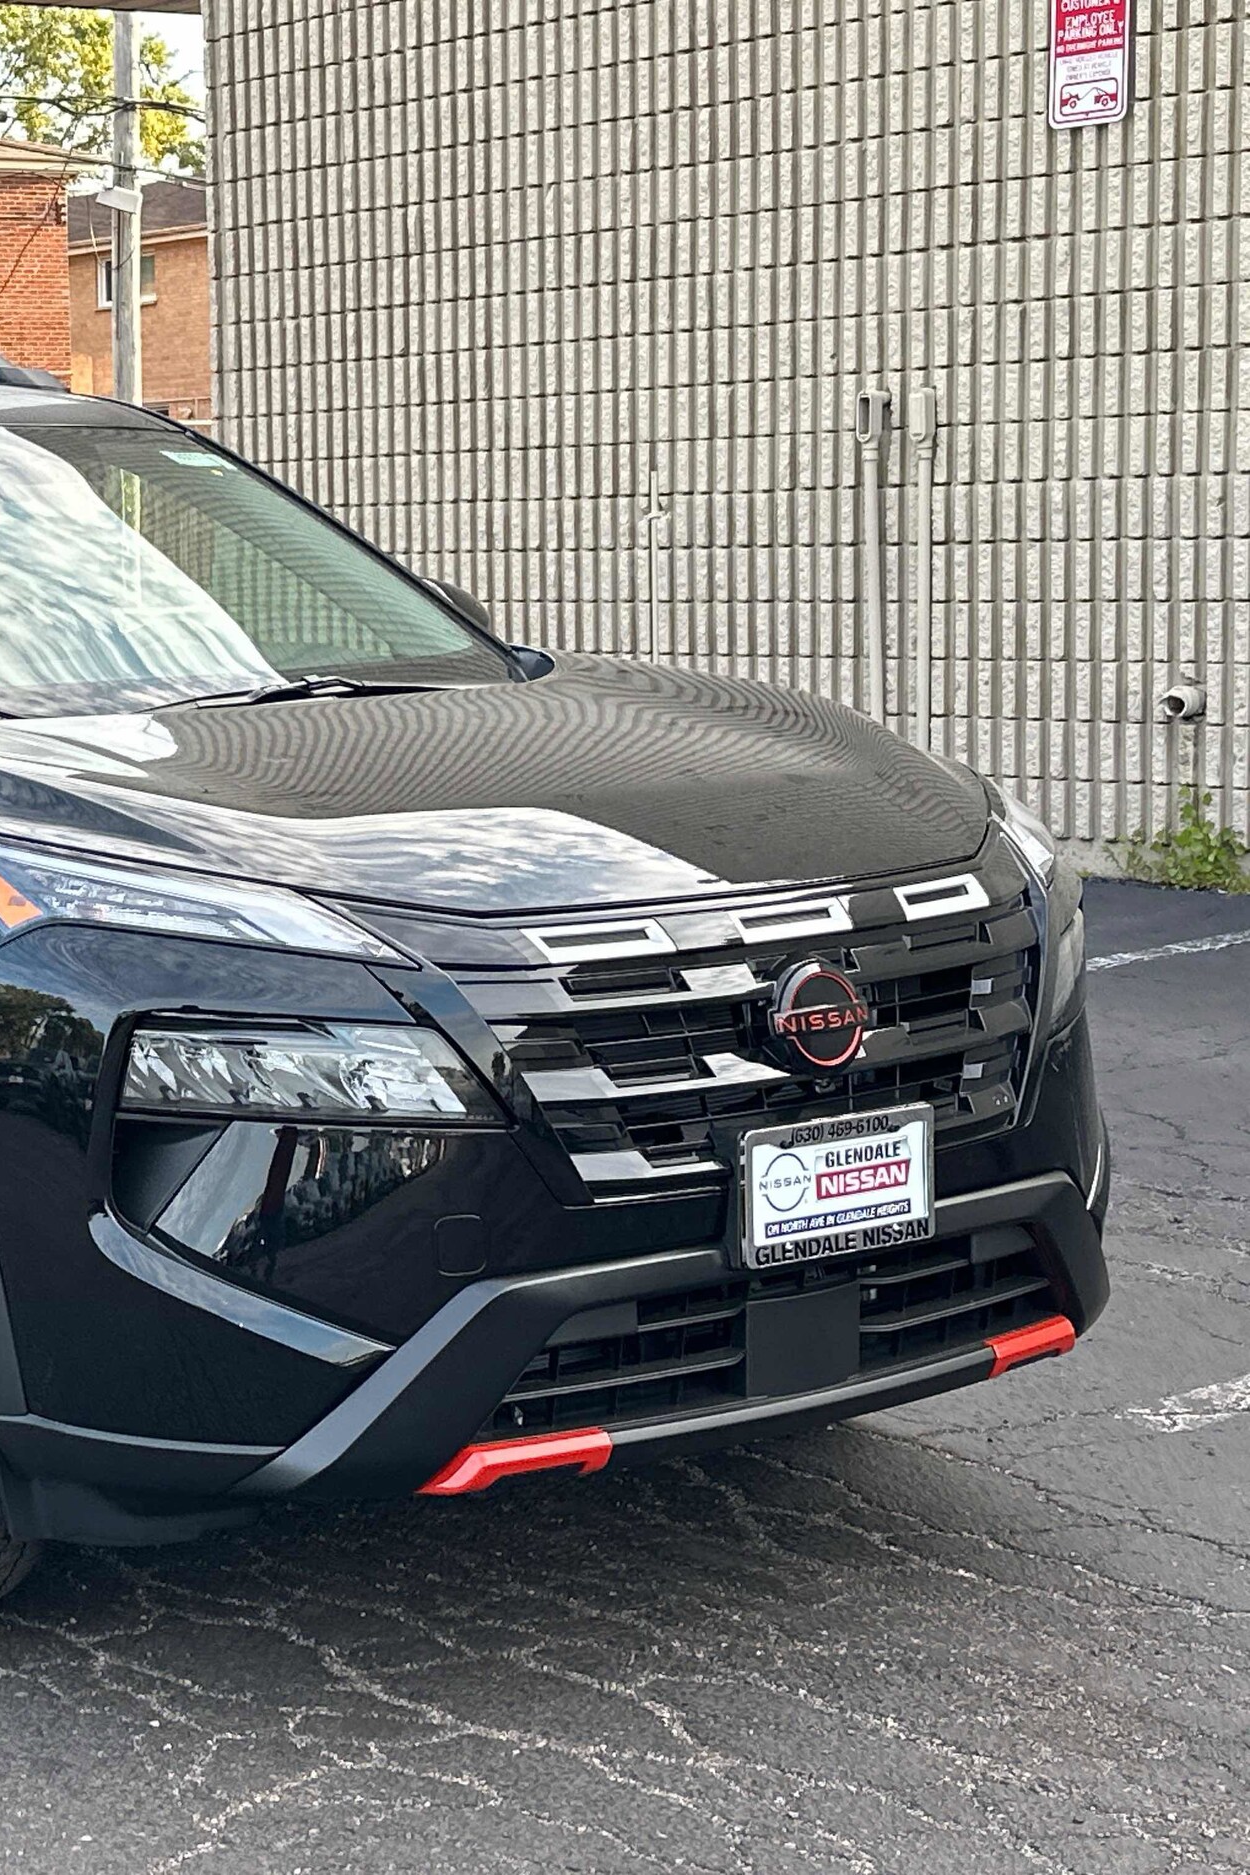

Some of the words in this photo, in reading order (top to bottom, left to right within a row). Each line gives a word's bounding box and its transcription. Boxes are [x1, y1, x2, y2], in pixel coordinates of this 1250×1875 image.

[1057, 26, 1098, 43] PARKING
[1098, 20, 1125, 36] ONLY
[1065, 9, 1116, 29] EMPLOYEE
[776, 1006, 869, 1034] NISSAN
[791, 1123, 824, 1144] (630)
[828, 1115, 889, 1138] 469-6100
[825, 1140, 901, 1168] GLENDALE
[759, 1174, 812, 1192] NISSAN
[820, 1163, 907, 1197] NISSAN
[781, 1219, 809, 1233] NORTH
[809, 1215, 825, 1229] AVE
[836, 1207, 876, 1224] GLENDALE
[876, 1201, 909, 1217] HEIGHTS
[755, 1233, 858, 1267] GLENDALE
[862, 1218, 930, 1248] NISSAN
